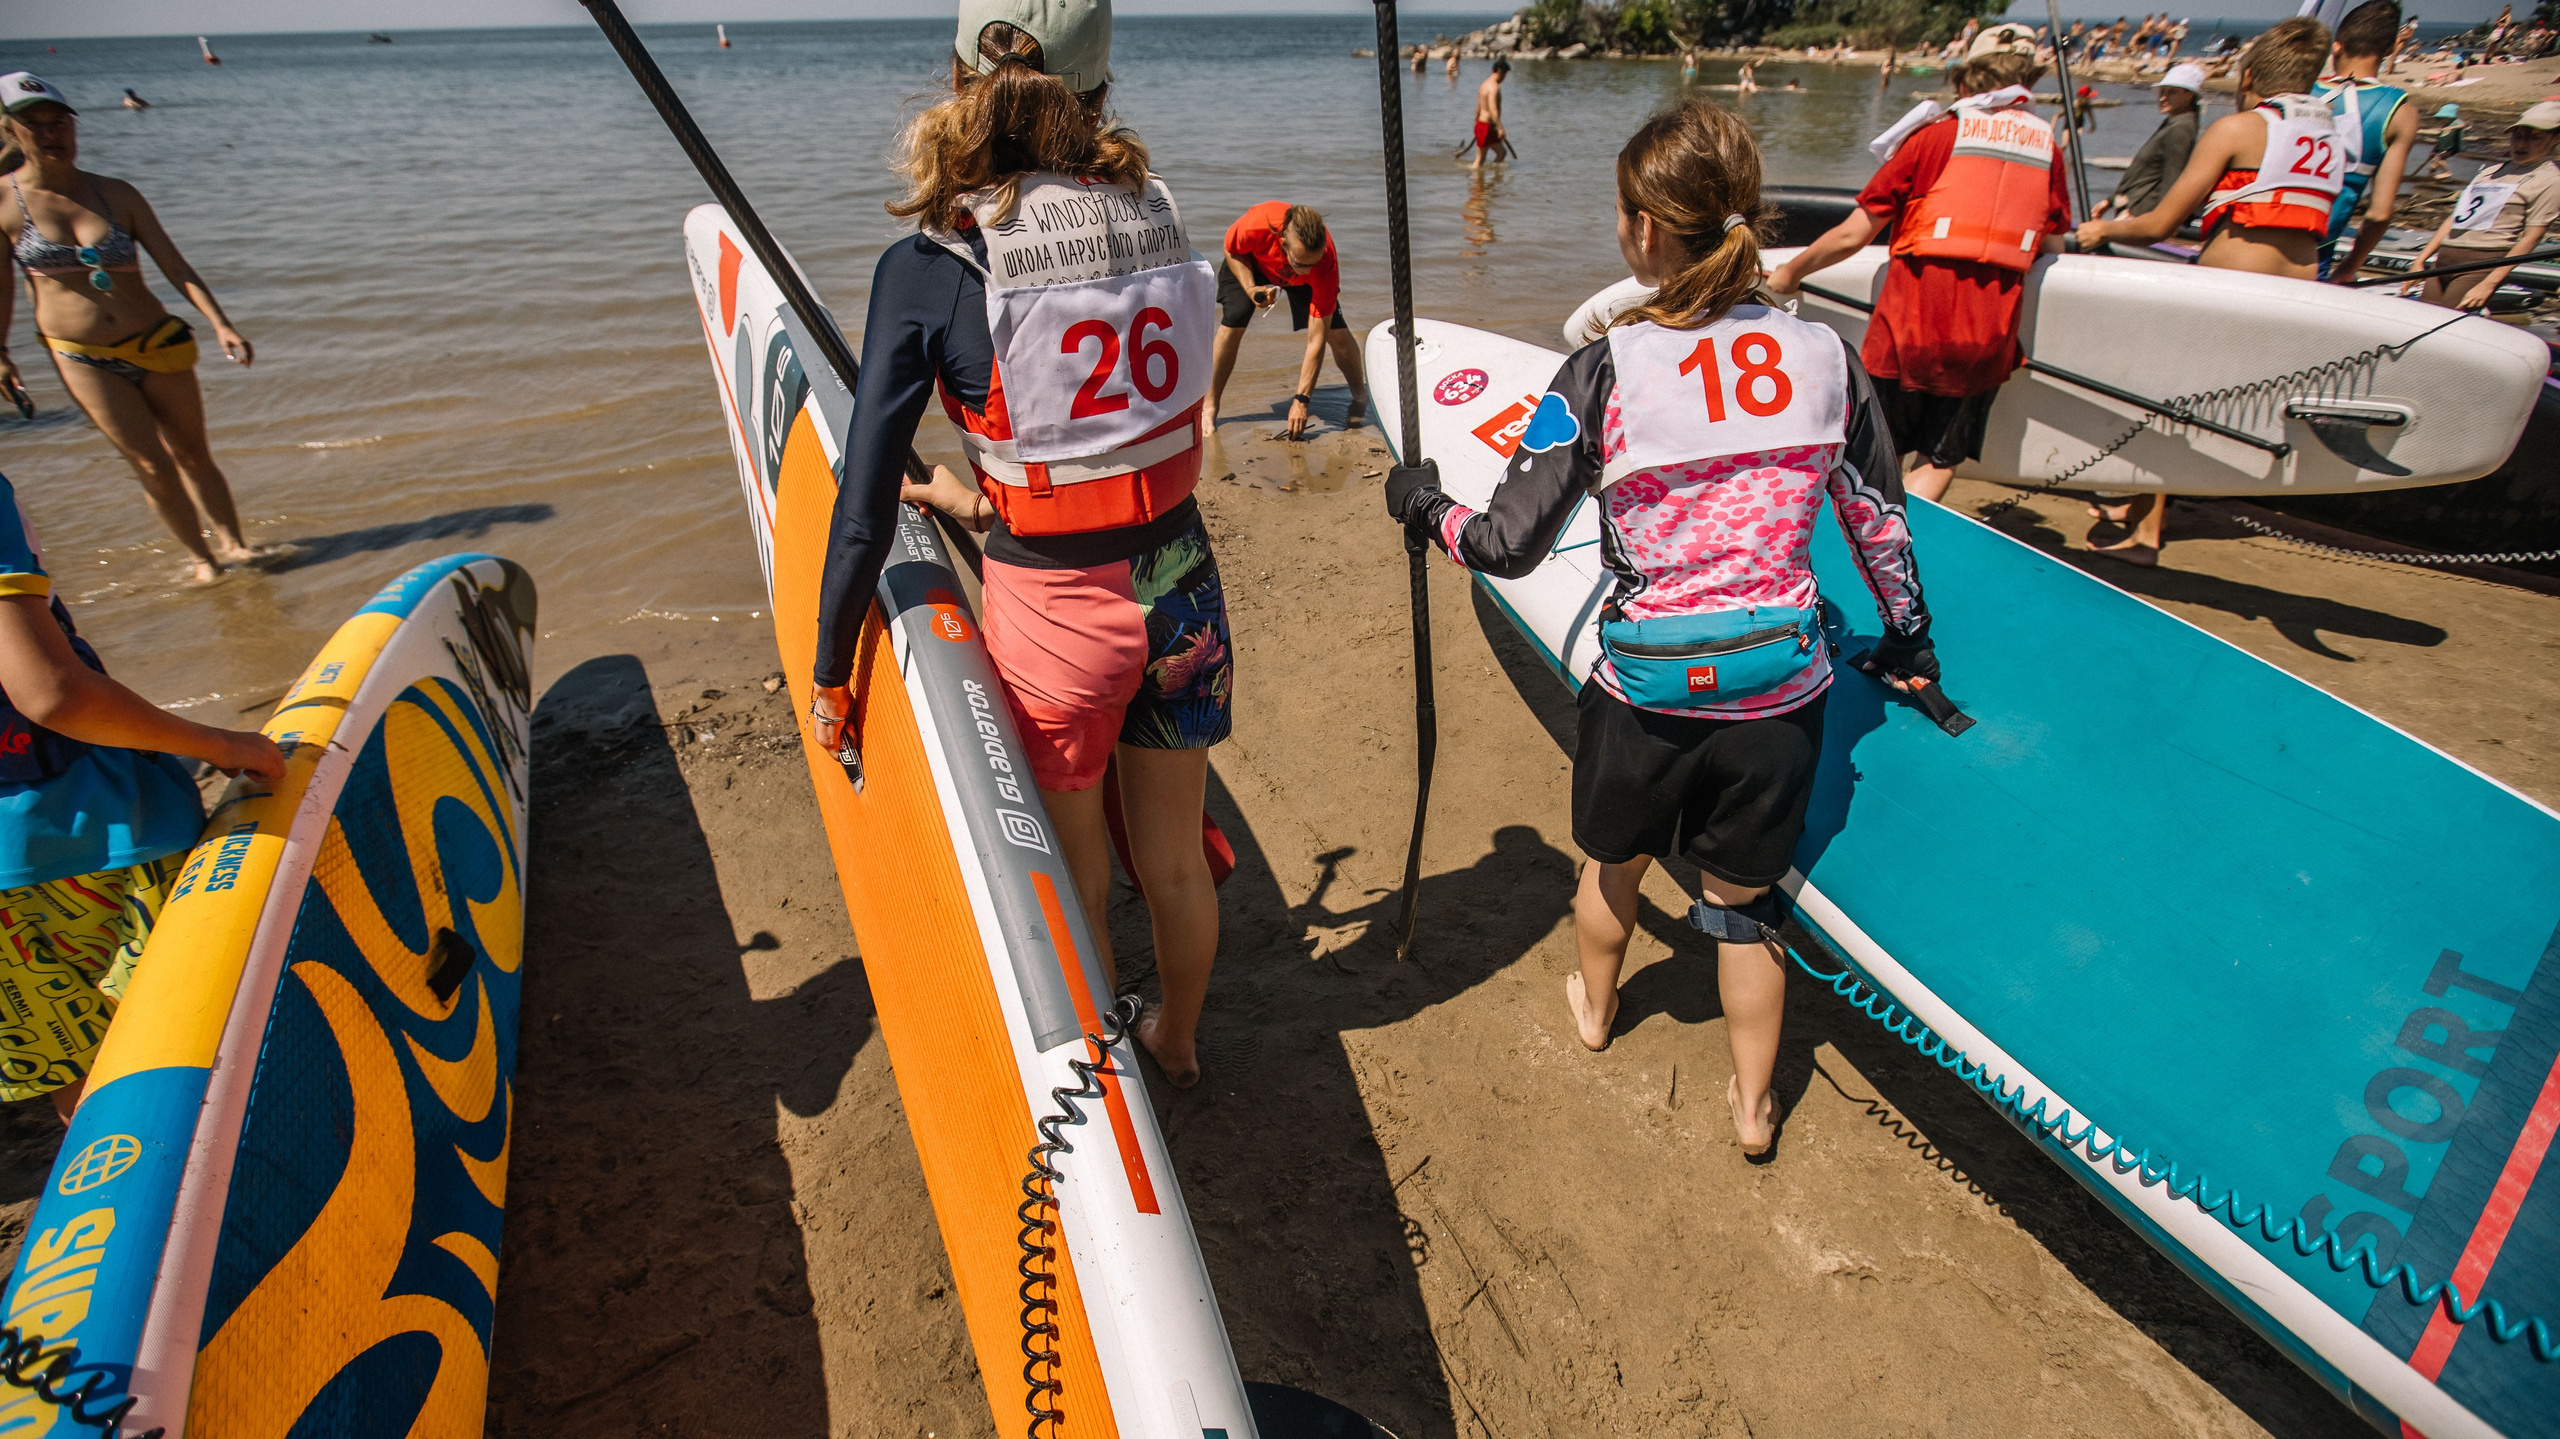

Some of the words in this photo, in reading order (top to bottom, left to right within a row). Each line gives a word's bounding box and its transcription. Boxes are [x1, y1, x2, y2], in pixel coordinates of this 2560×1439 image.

[2289, 136, 2332, 180] 22
[2454, 195, 2484, 223] 3
[1002, 243, 1054, 279] ШКОЛА
[1055, 231, 1134, 267] ПАРУСНОГО
[1137, 224, 1181, 255] СПОРТА
[1060, 306, 1179, 420] 26
[1438, 372, 1464, 390] ДОСКА
[1678, 332, 1793, 424] 18
[1443, 373, 1482, 400] 634
[898, 523, 921, 562] LENGTH
[1690, 666, 1714, 686] red
[205, 821, 259, 892] THICKNESS
[2, 977, 34, 1018] TERMIT
[47, 1020, 79, 1058] TERMIT
[2300, 948, 2525, 1288] SPORT
